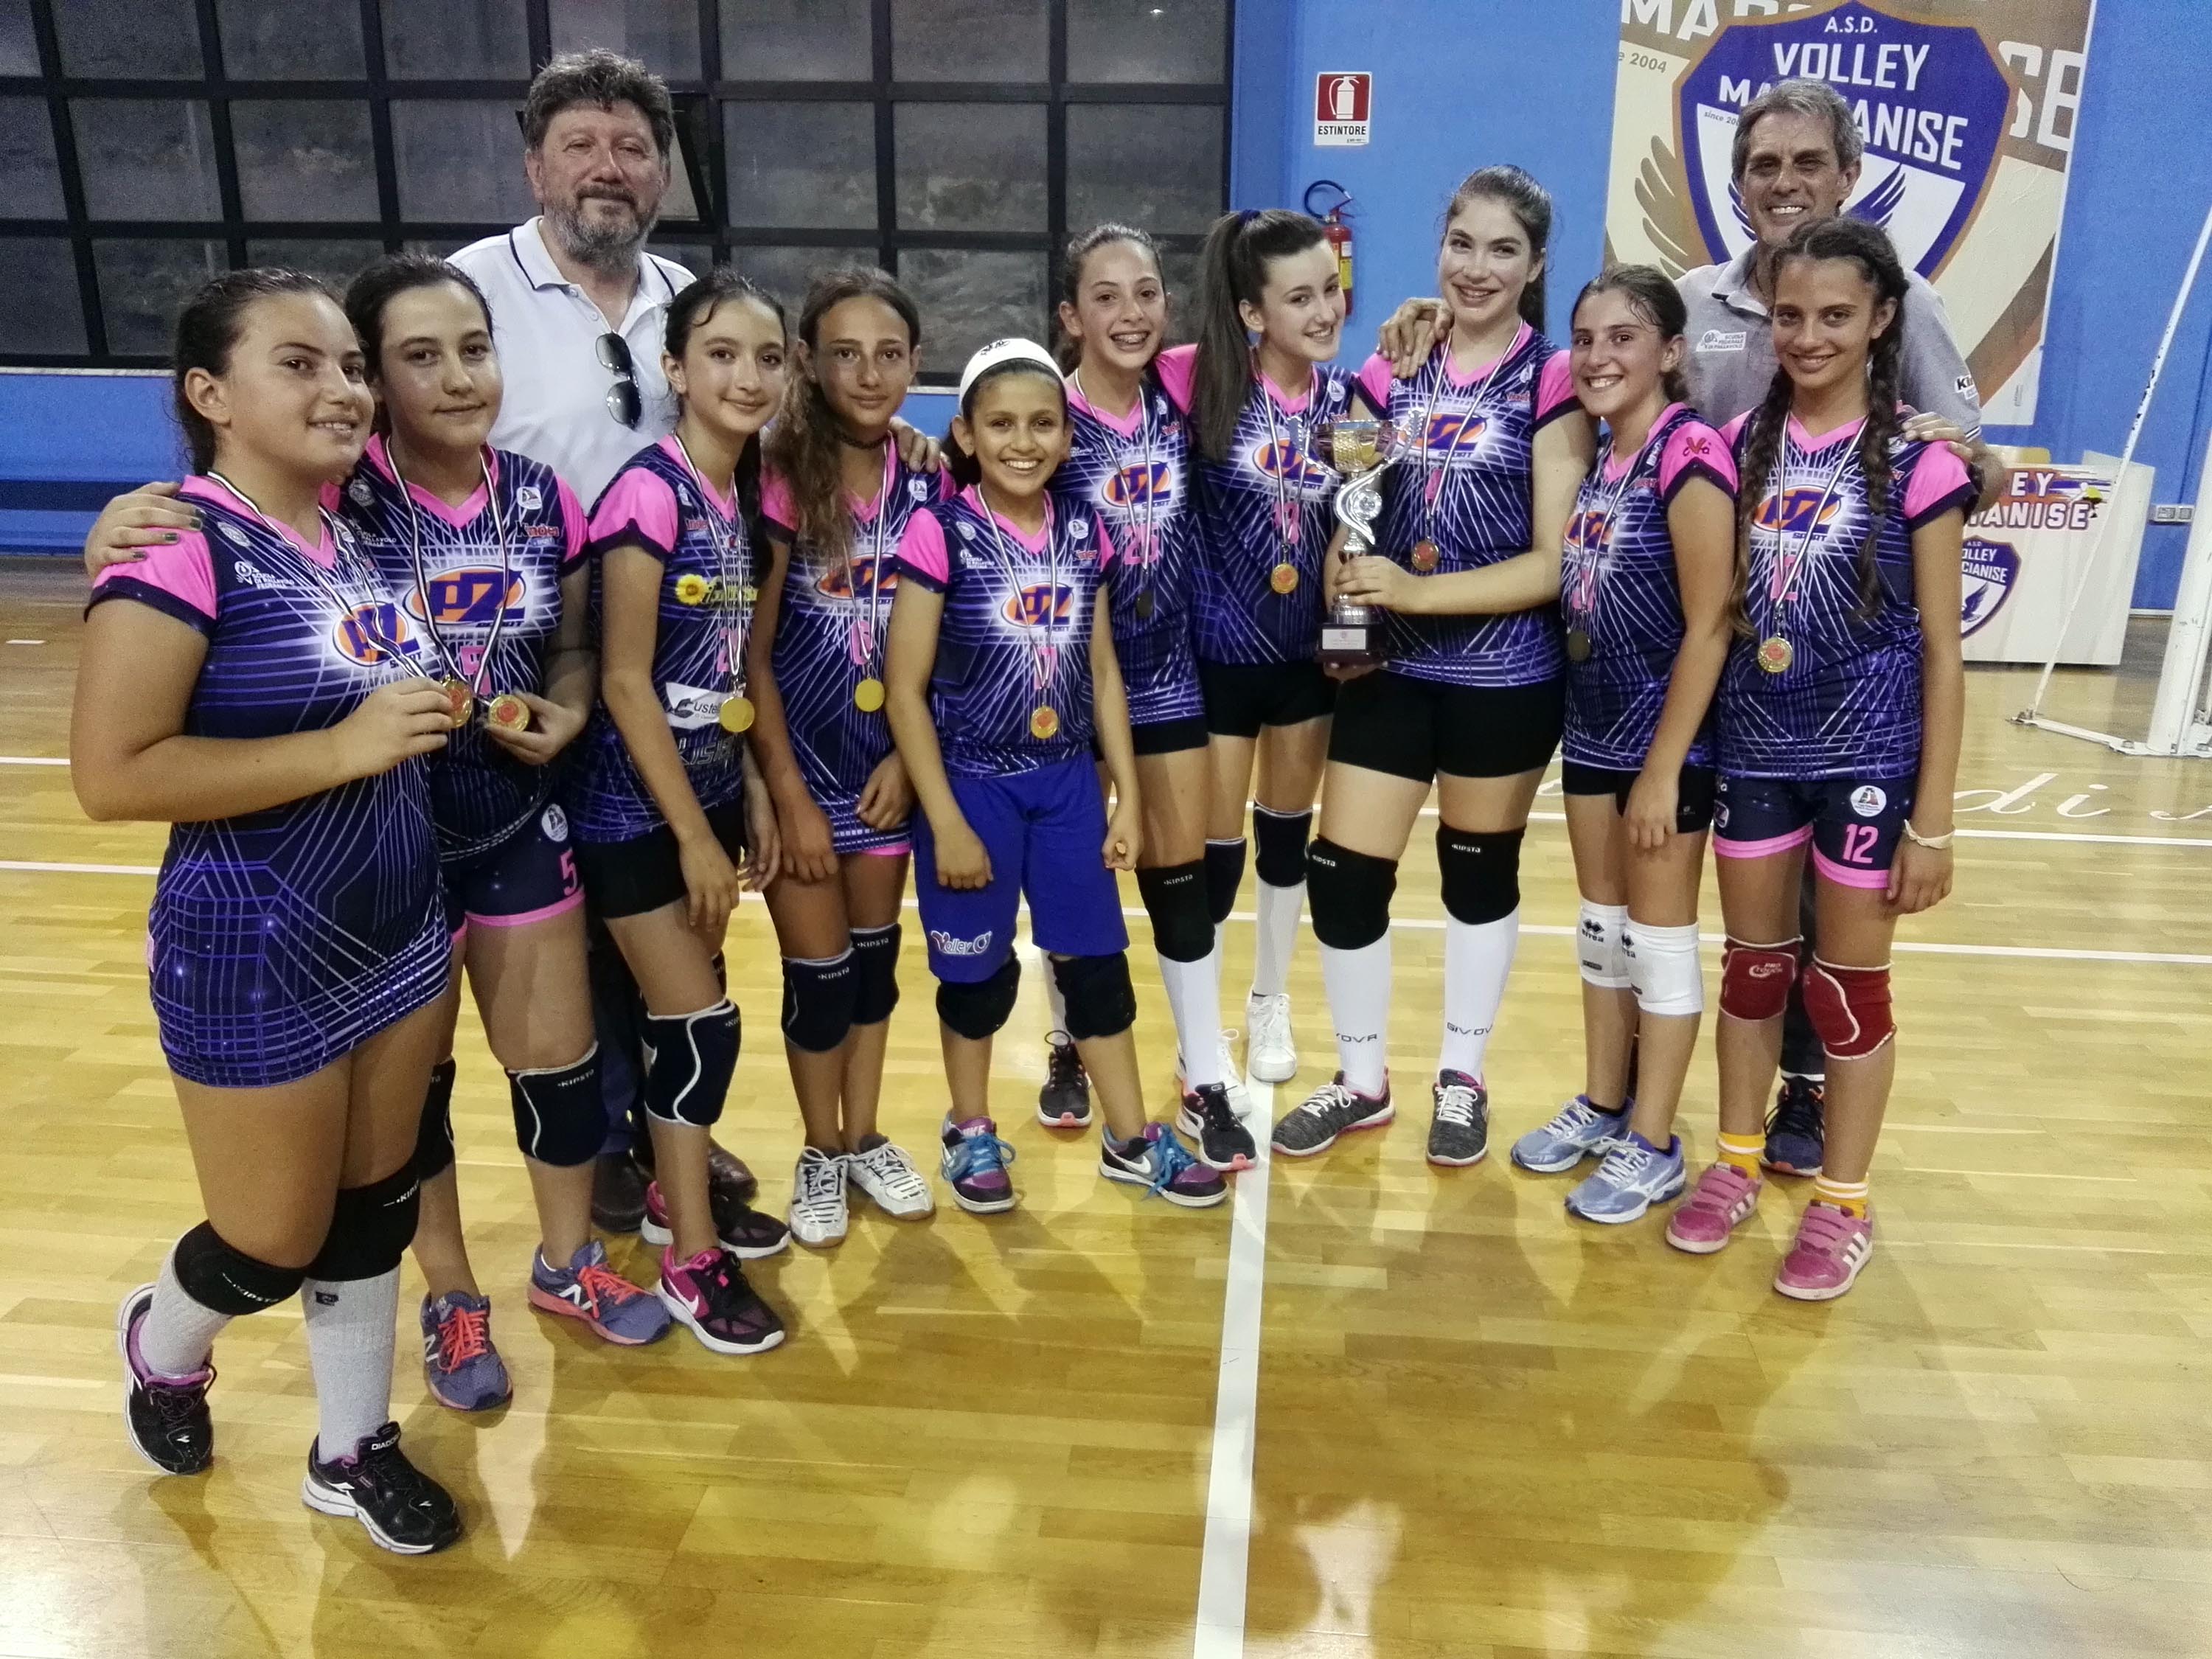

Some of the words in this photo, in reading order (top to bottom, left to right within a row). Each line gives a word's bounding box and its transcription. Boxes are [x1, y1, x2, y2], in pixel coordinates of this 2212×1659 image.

[1824, 16, 1878, 33] A.S.D.
[1630, 52, 1667, 73] 2004
[1773, 43, 1930, 91] VOLLEY
[1318, 125, 1367, 136] ESTINTORE
[1843, 823, 1879, 863] 12
[560, 847, 578, 897] 5
